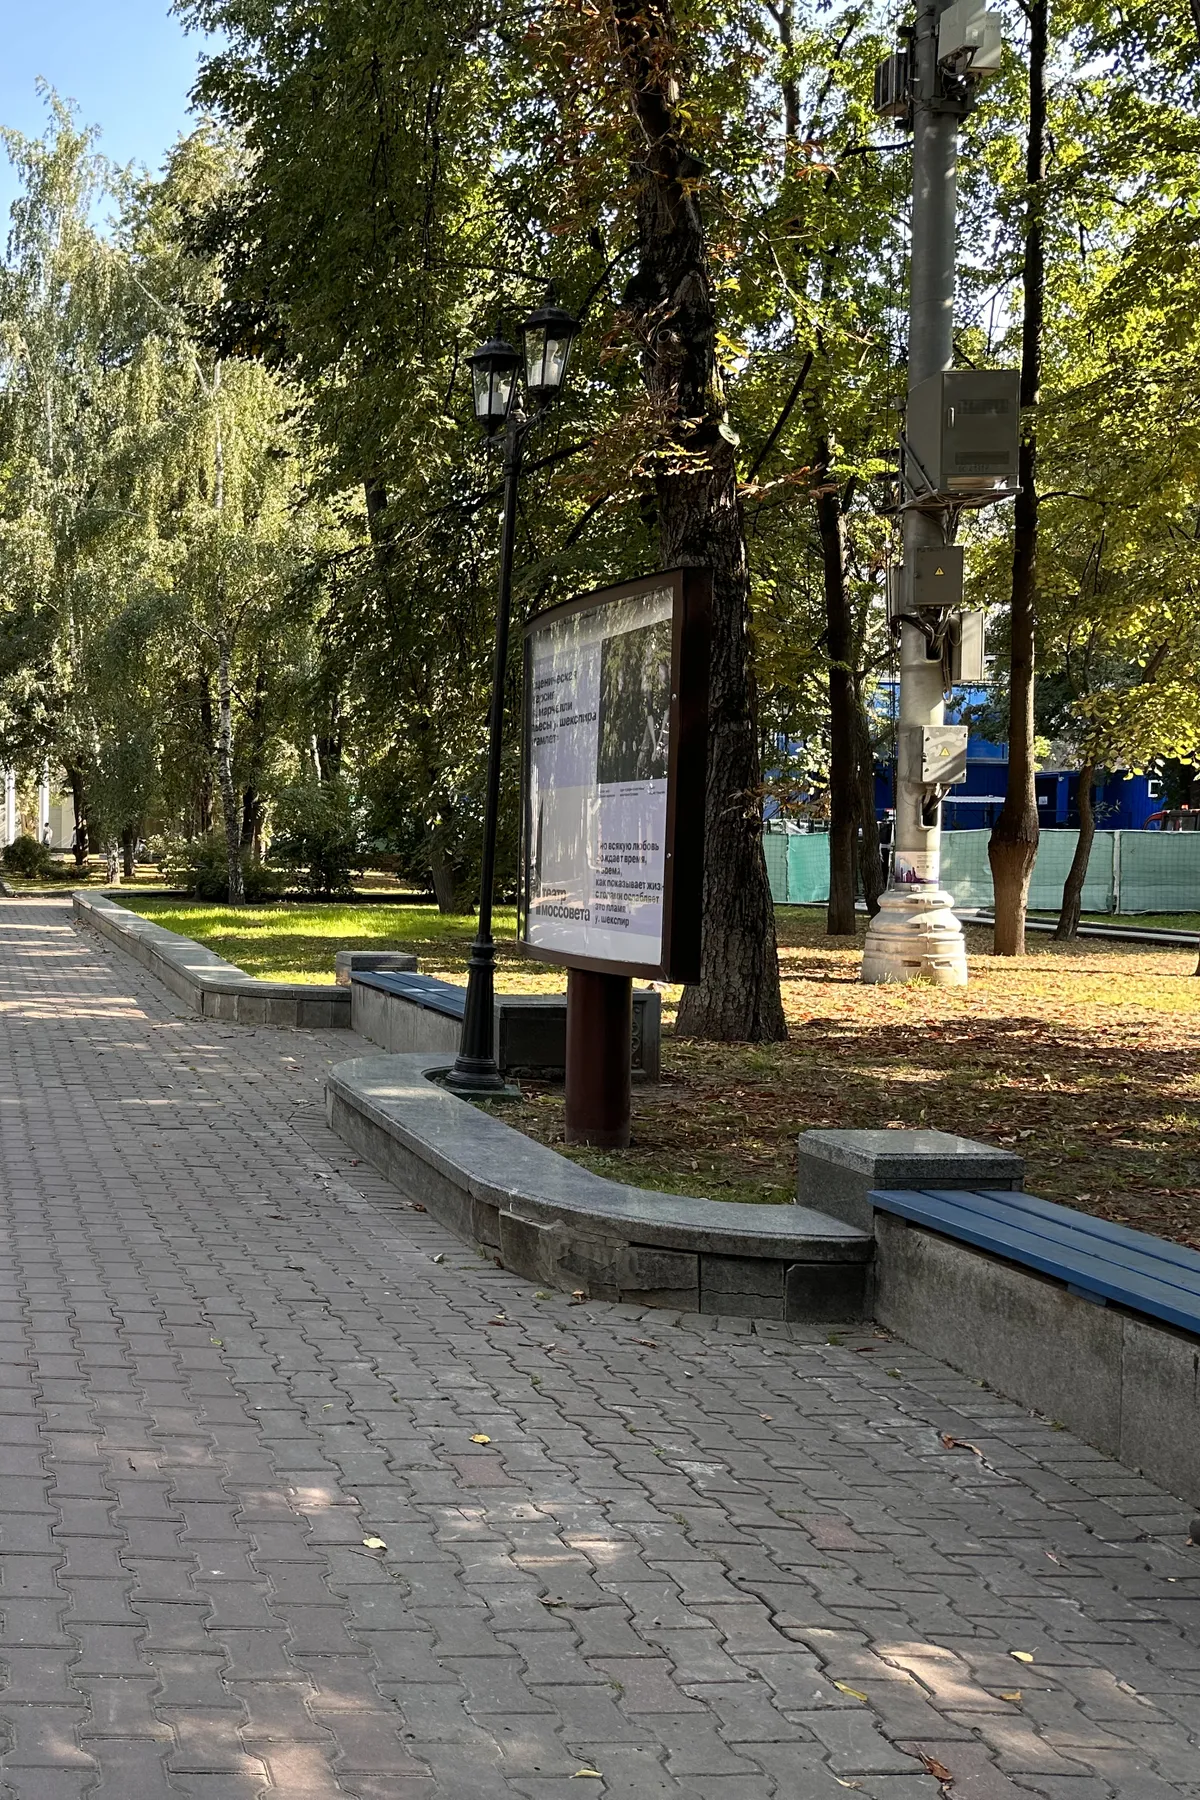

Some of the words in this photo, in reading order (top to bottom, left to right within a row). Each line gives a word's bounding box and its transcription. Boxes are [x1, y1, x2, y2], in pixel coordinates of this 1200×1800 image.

[608, 843, 632, 853] всякую
[596, 879, 606, 887] как
[607, 879, 646, 890] показывает
[541, 904, 590, 921] моссовета
[601, 915, 630, 928] шекспир
